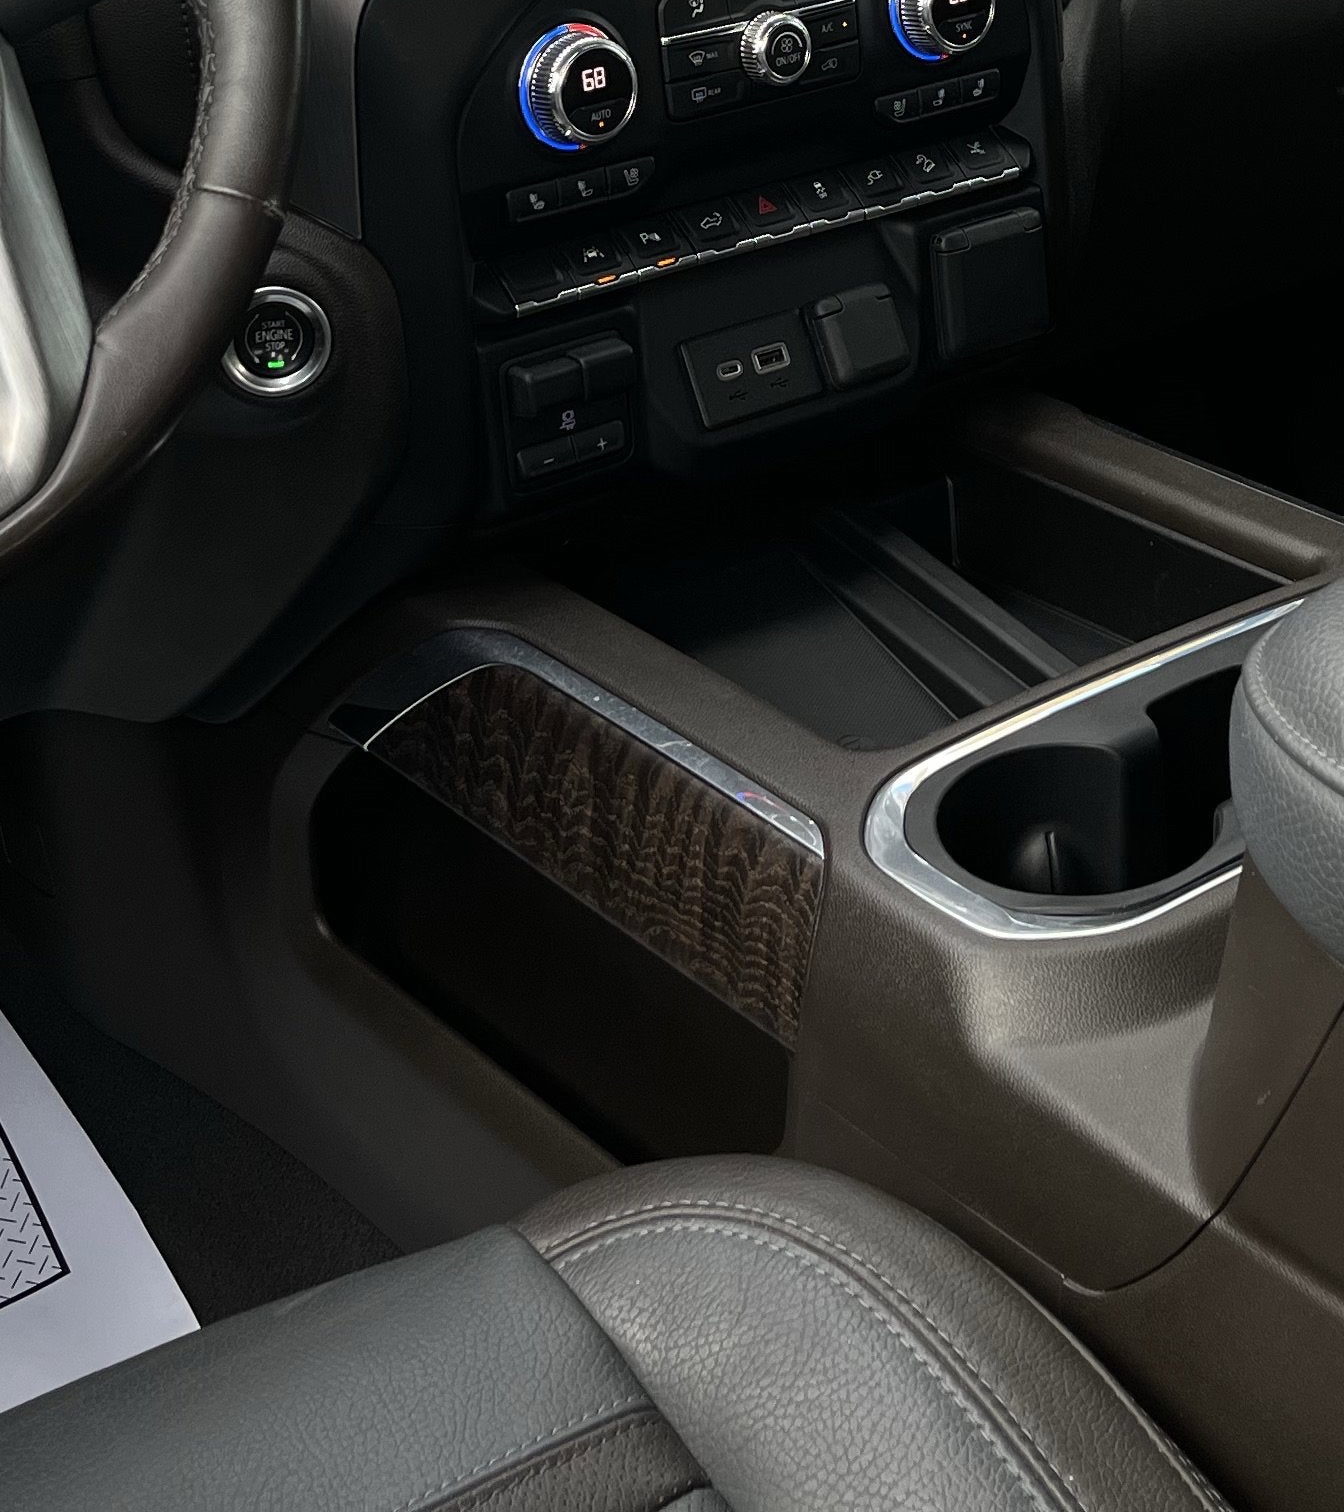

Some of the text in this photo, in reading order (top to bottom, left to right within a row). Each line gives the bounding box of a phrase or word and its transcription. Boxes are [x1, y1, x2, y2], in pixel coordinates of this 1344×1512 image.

[821, 21, 835, 34] A/C
[775, 51, 802, 67] ON/OFF
[581, 66, 607, 92] 68
[590, 107, 612, 121] AUTO
[261, 319, 286, 330] START
[255, 328, 295, 344] ENGINE
[264, 340, 287, 352] STOP
